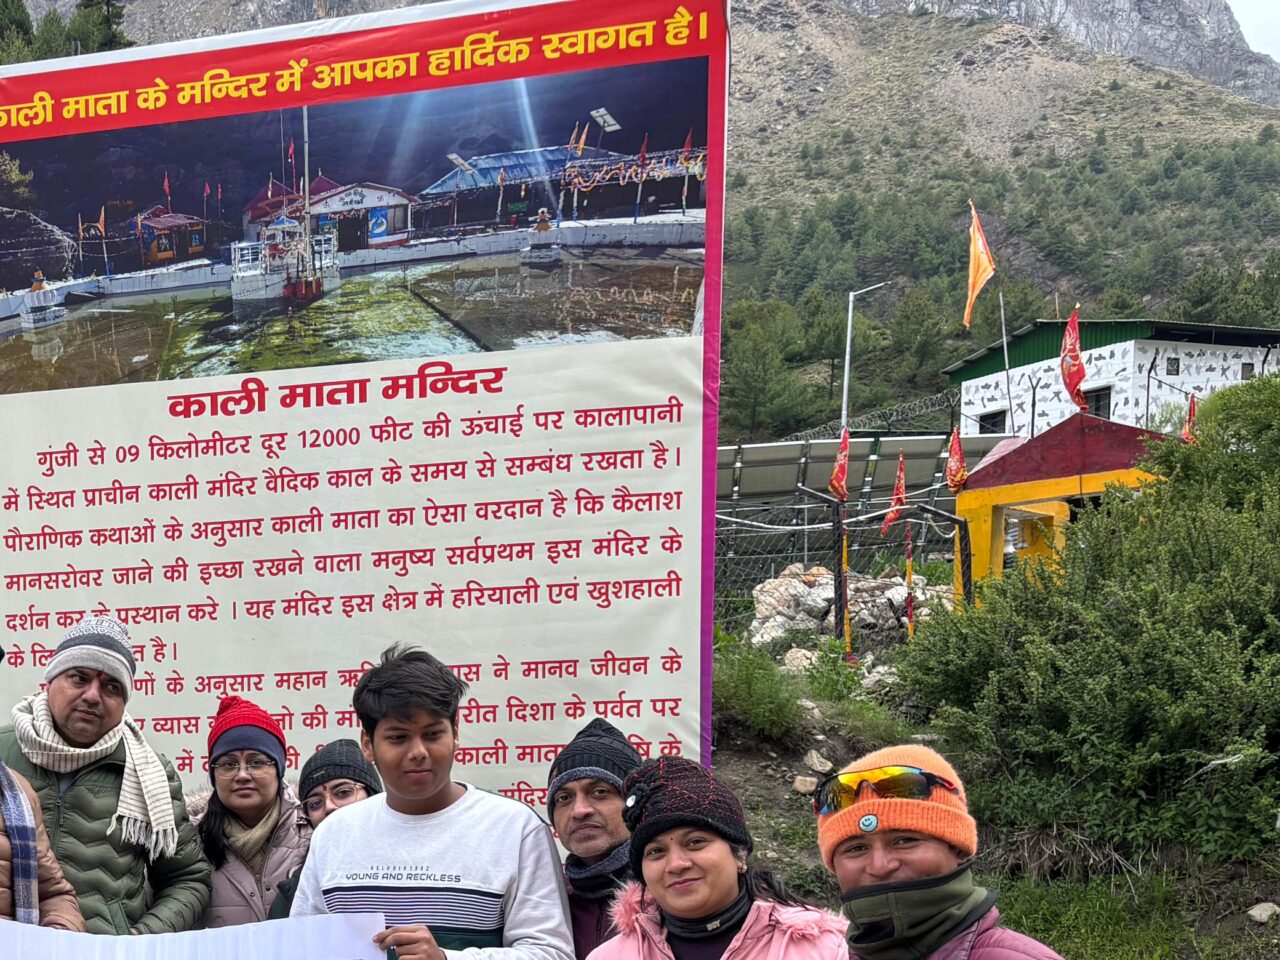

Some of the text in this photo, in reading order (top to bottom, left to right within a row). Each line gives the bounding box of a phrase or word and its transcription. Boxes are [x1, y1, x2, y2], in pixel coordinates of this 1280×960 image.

[63, 91, 128, 118] माता
[137, 79, 168, 109] के
[177, 69, 268, 104] मन्दिर
[276, 59, 308, 92] में
[312, 53, 419, 88] आपका
[429, 32, 533, 75] हार्दिक
[542, 22, 656, 58] स्वागत
[168, 361, 507, 418] काली माता मन्दिर
[37, 396, 683, 477] गुंजी से 09 किलोमीटर दूर 12000 फीट की ऊंचाई पर कालापानी
[4, 448, 644, 510] में स्थित प्राचीन काली मंदिर वैदिक काल समय से सम्बंध रखता
[4, 488, 681, 551] पौराणिक कथाओं अनुसार काली माता का ऐसा वरदान है कि कैलाश
[6, 530, 649, 591] मानसरोवर जाने की इच्छा रखने वाला मनुष्य सर्वप्रथम इस मंदिर
[7, 605, 49, 630] दर्शन
[117, 605, 180, 624] प्रस्थान
[188, 596, 218, 621] करे
[246, 601, 274, 619] यह
[283, 591, 333, 615] मंदिर
[340, 594, 374, 618] इस
[383, 586, 418, 609] क्षेत्र
[424, 584, 443, 608] में
[452, 578, 540, 608] हरियाली
[548, 577, 579, 604] एवं
[588, 570, 682, 608] खुशहाली
[195, 674, 264, 701] अनुसार
[276, 672, 327, 689] महान
[494, 656, 510, 678] ने
[523, 660, 578, 678] मानव
[592, 651, 649, 675] जीवन
[662, 648, 682, 672] के
[153, 716, 200, 734] व्यास
[303, 704, 328, 728] की
[507, 696, 556, 721] दिशा
[564, 694, 585, 718] के
[594, 691, 642, 718] पर्वत
[651, 698, 681, 717] पर
[178, 750, 194, 771] में
[455, 739, 508, 764] काली
[345, 873, 379, 881] YOUNG
[406, 873, 461, 882] RECKLESS
